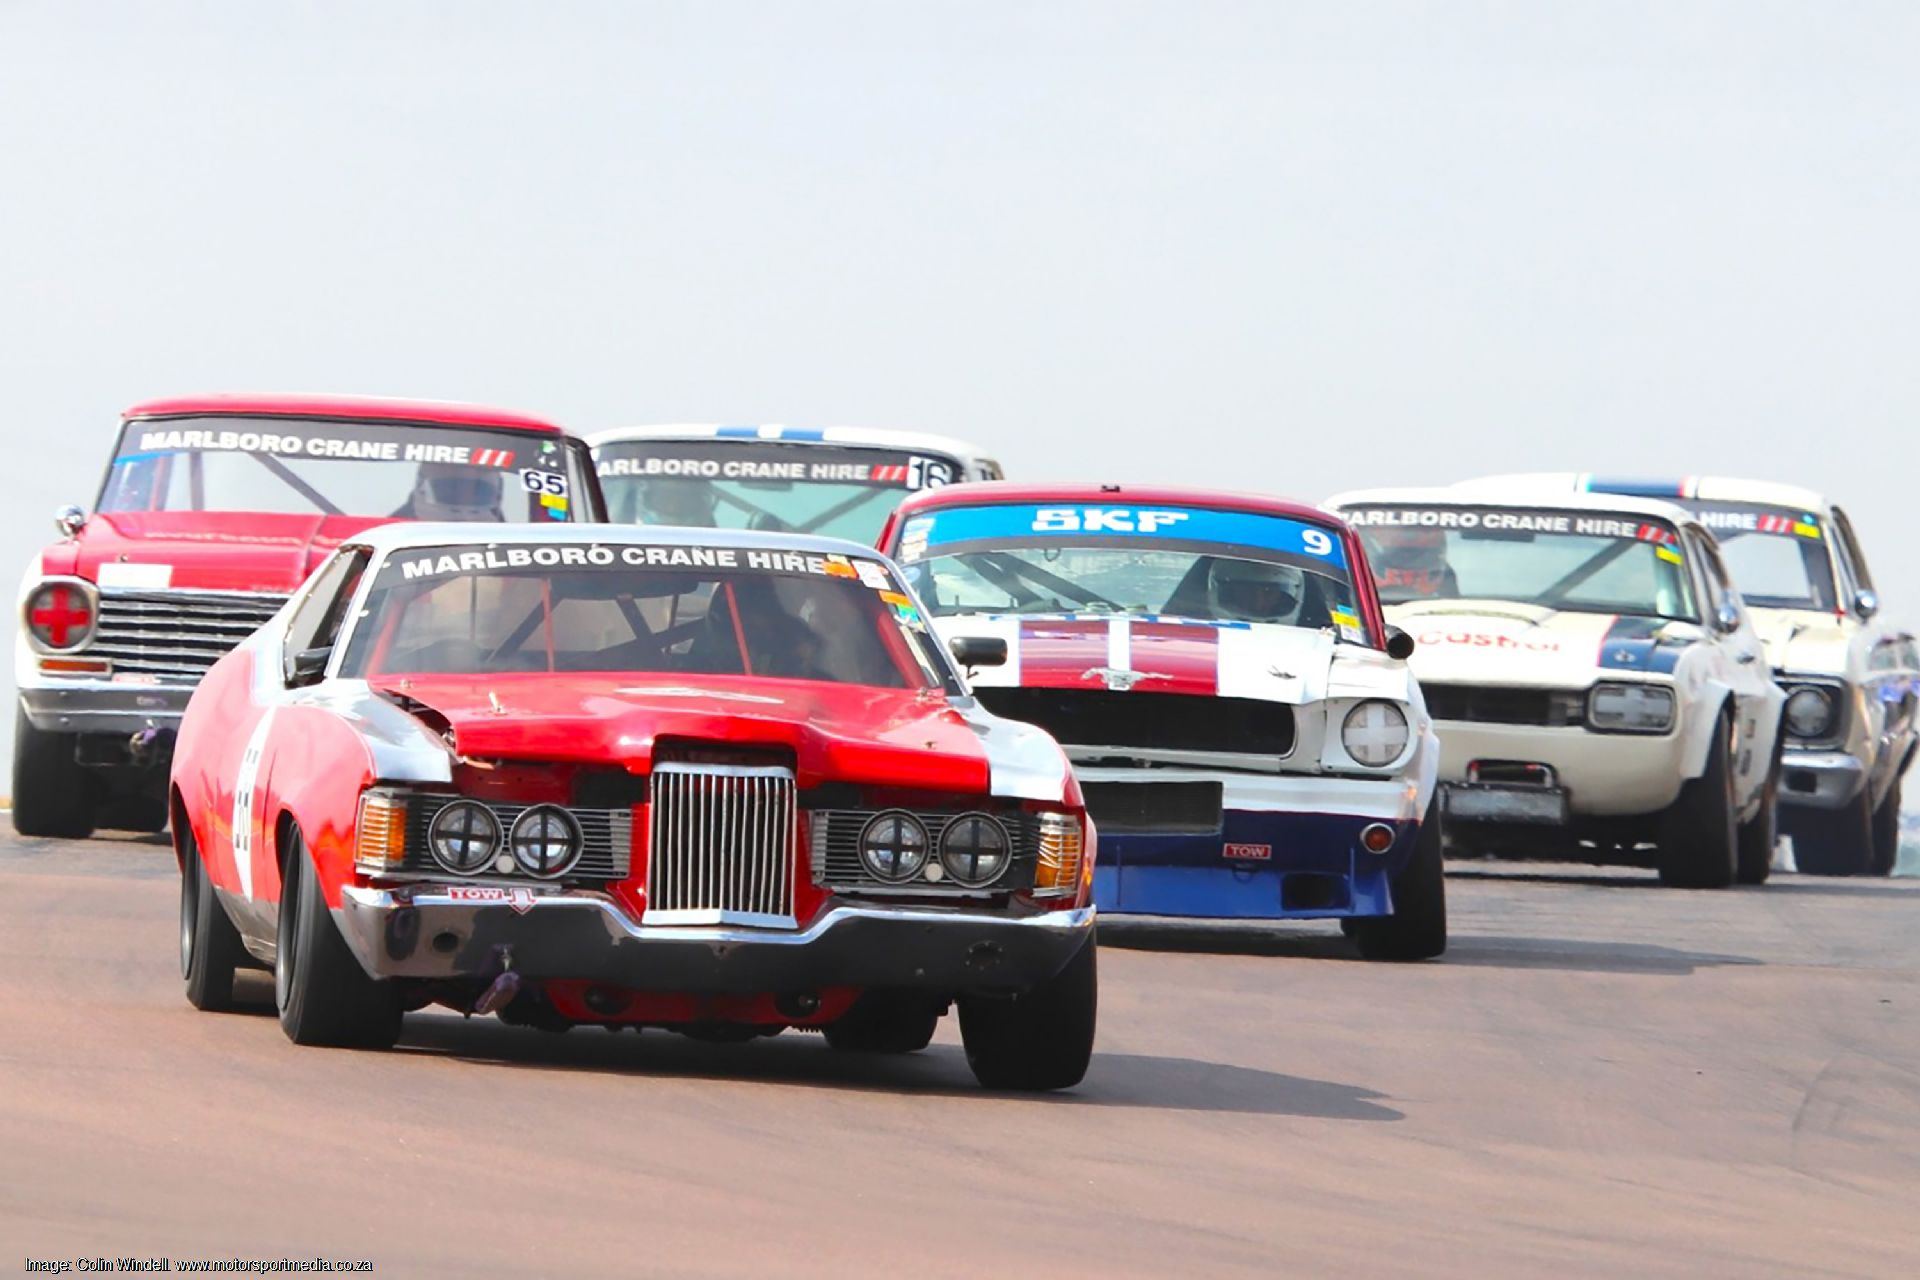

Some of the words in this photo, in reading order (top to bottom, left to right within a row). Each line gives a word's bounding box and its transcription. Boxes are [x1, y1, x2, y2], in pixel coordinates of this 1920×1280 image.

[140, 430, 302, 453] MARLBORO
[306, 438, 399, 459] CRANE
[404, 443, 471, 464] HIRE
[597, 458, 720, 478] ARLBORO
[723, 461, 804, 479] CRANE
[811, 463, 870, 480] HIRE
[911, 460, 948, 489] 16
[523, 470, 565, 496] 65
[1031, 508, 1189, 533] SKF
[1483, 513, 1569, 532] CRANE
[1575, 518, 1637, 538] HIRE
[1700, 511, 1757, 530] HIRE
[1301, 529, 1333, 556] 9
[402, 547, 615, 579] MARLBORO
[621, 547, 738, 567] CRANE
[748, 551, 826, 575] HIRE
[1417, 630, 1560, 652] Castrol
[1230, 845, 1265, 857] TOW
[452, 889, 498, 899] TOW
